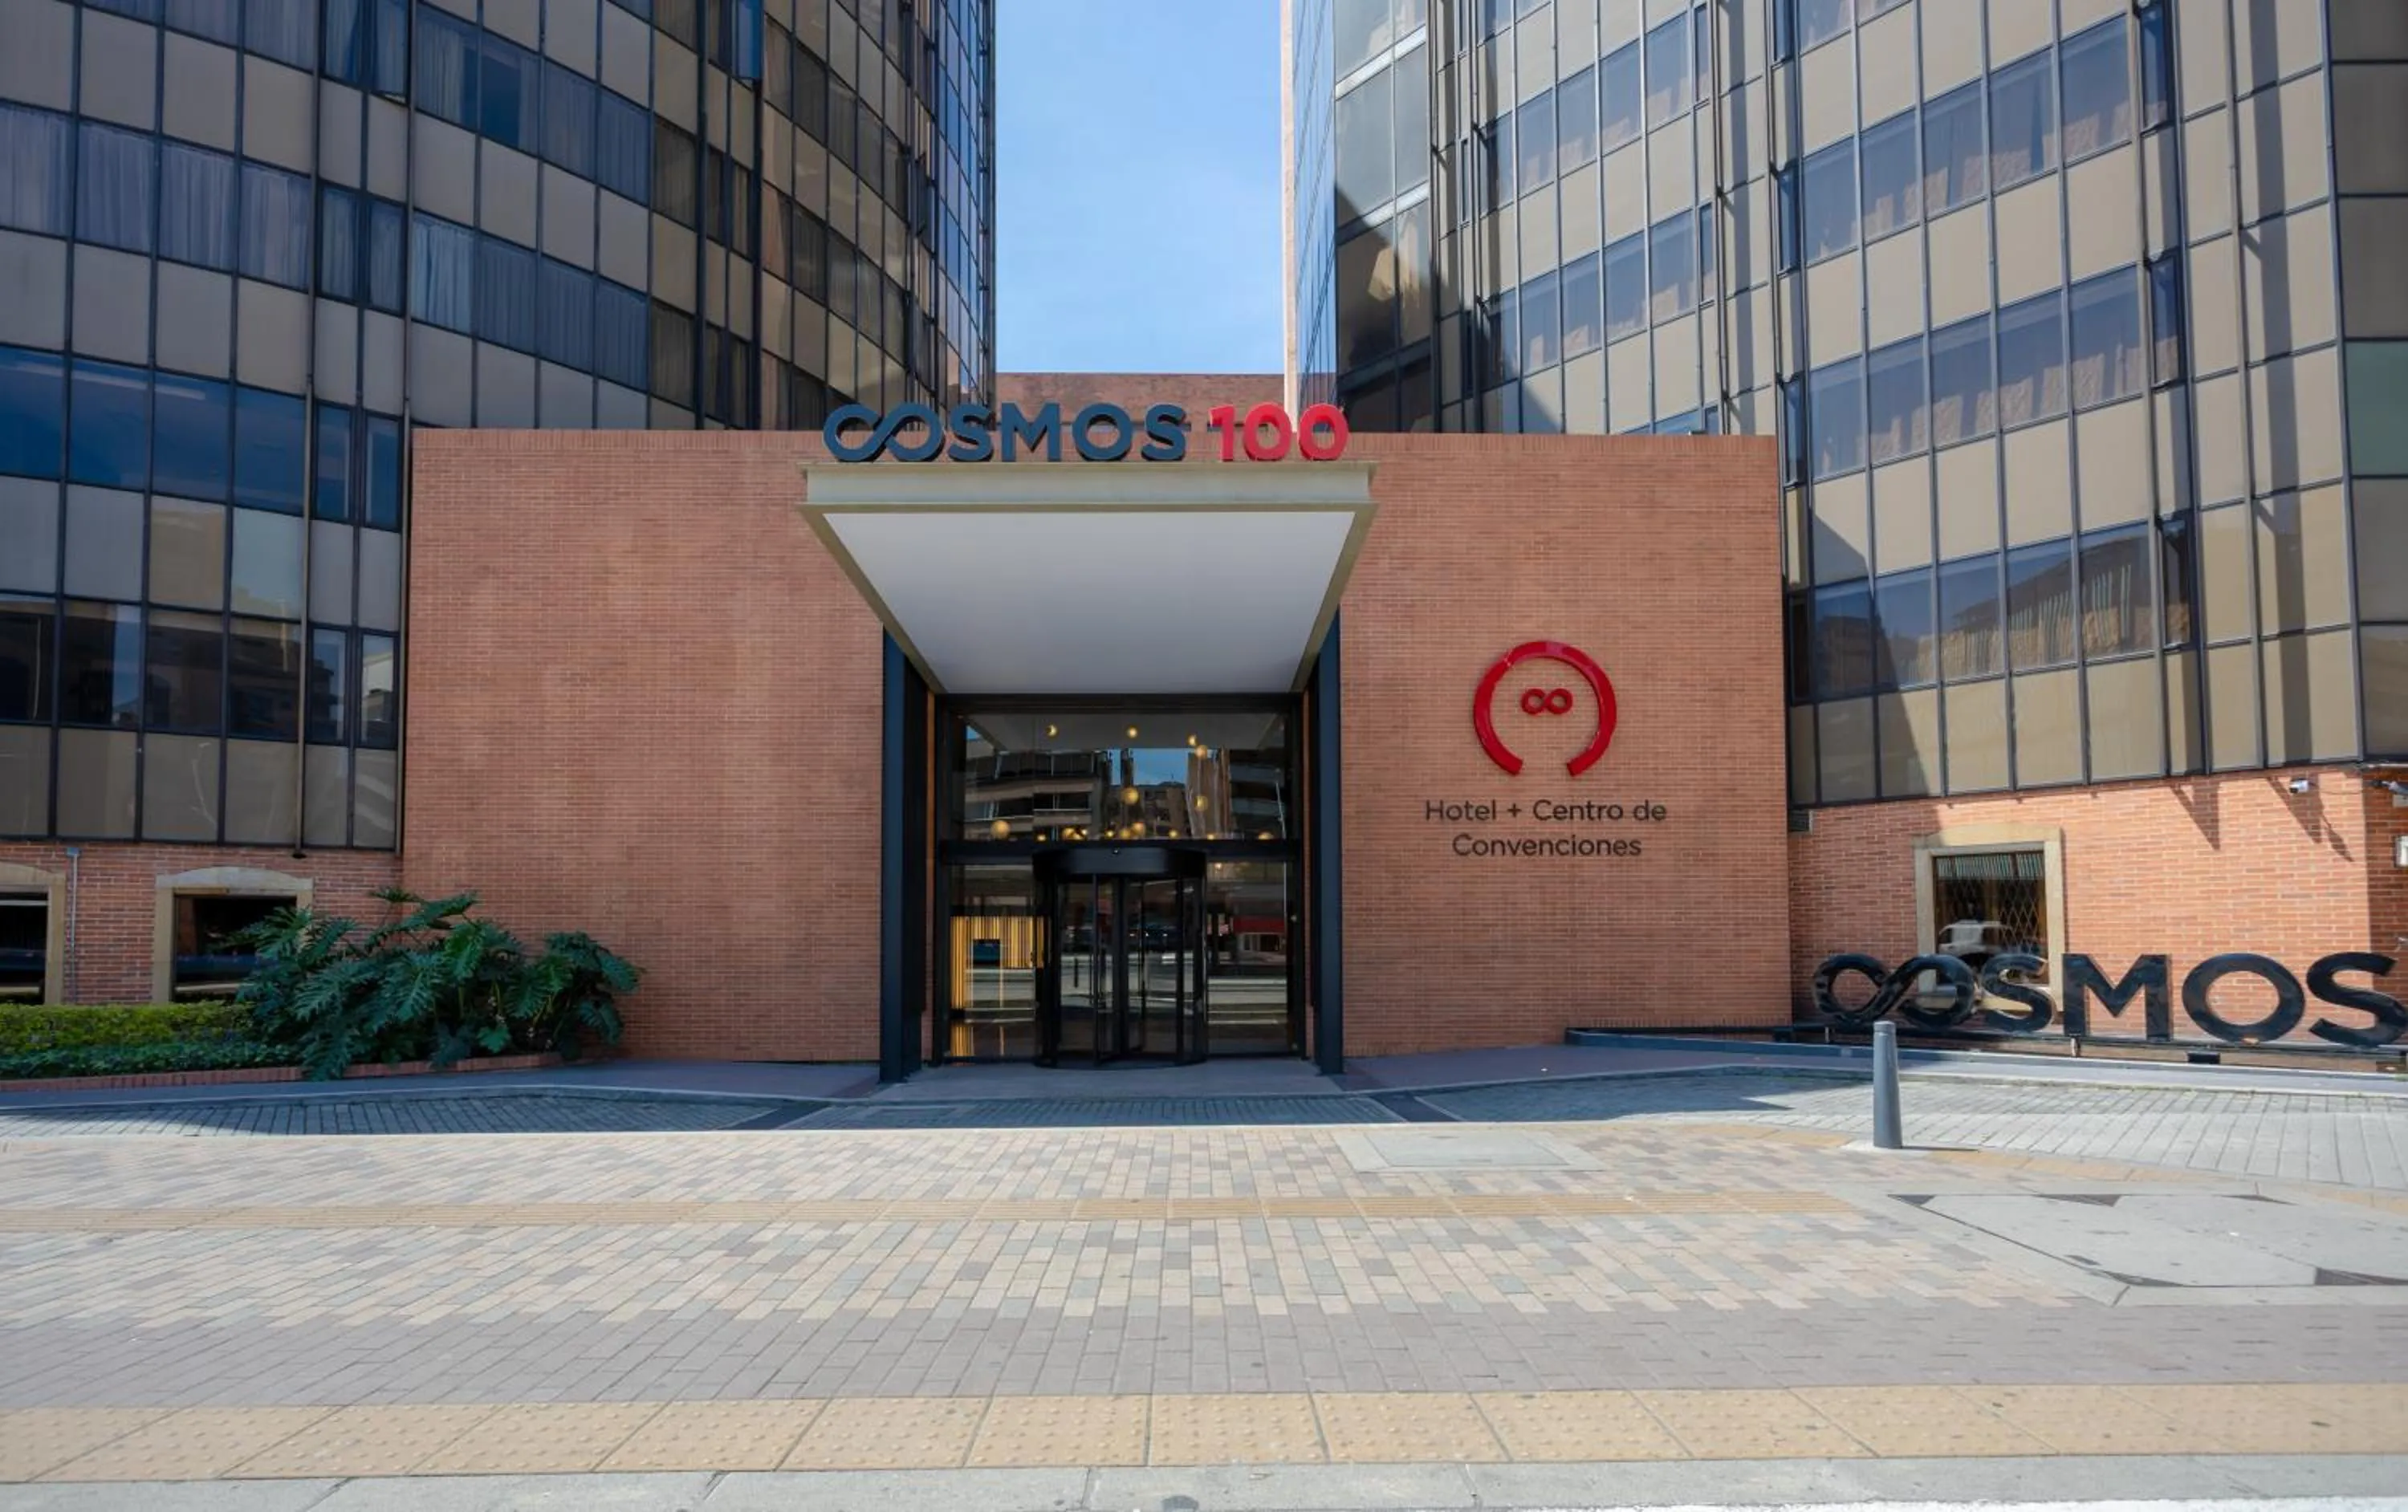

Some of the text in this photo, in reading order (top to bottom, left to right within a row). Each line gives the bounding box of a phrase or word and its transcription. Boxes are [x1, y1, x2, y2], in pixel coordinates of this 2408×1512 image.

[823, 402, 1349, 462] COSMOS 100
[1425, 799, 1497, 821] Hotel
[1532, 799, 1625, 821] Centro
[1632, 799, 1668, 821] de
[1451, 832, 1643, 857] Convenciones
[1813, 951, 2408, 1047] COSMOS
